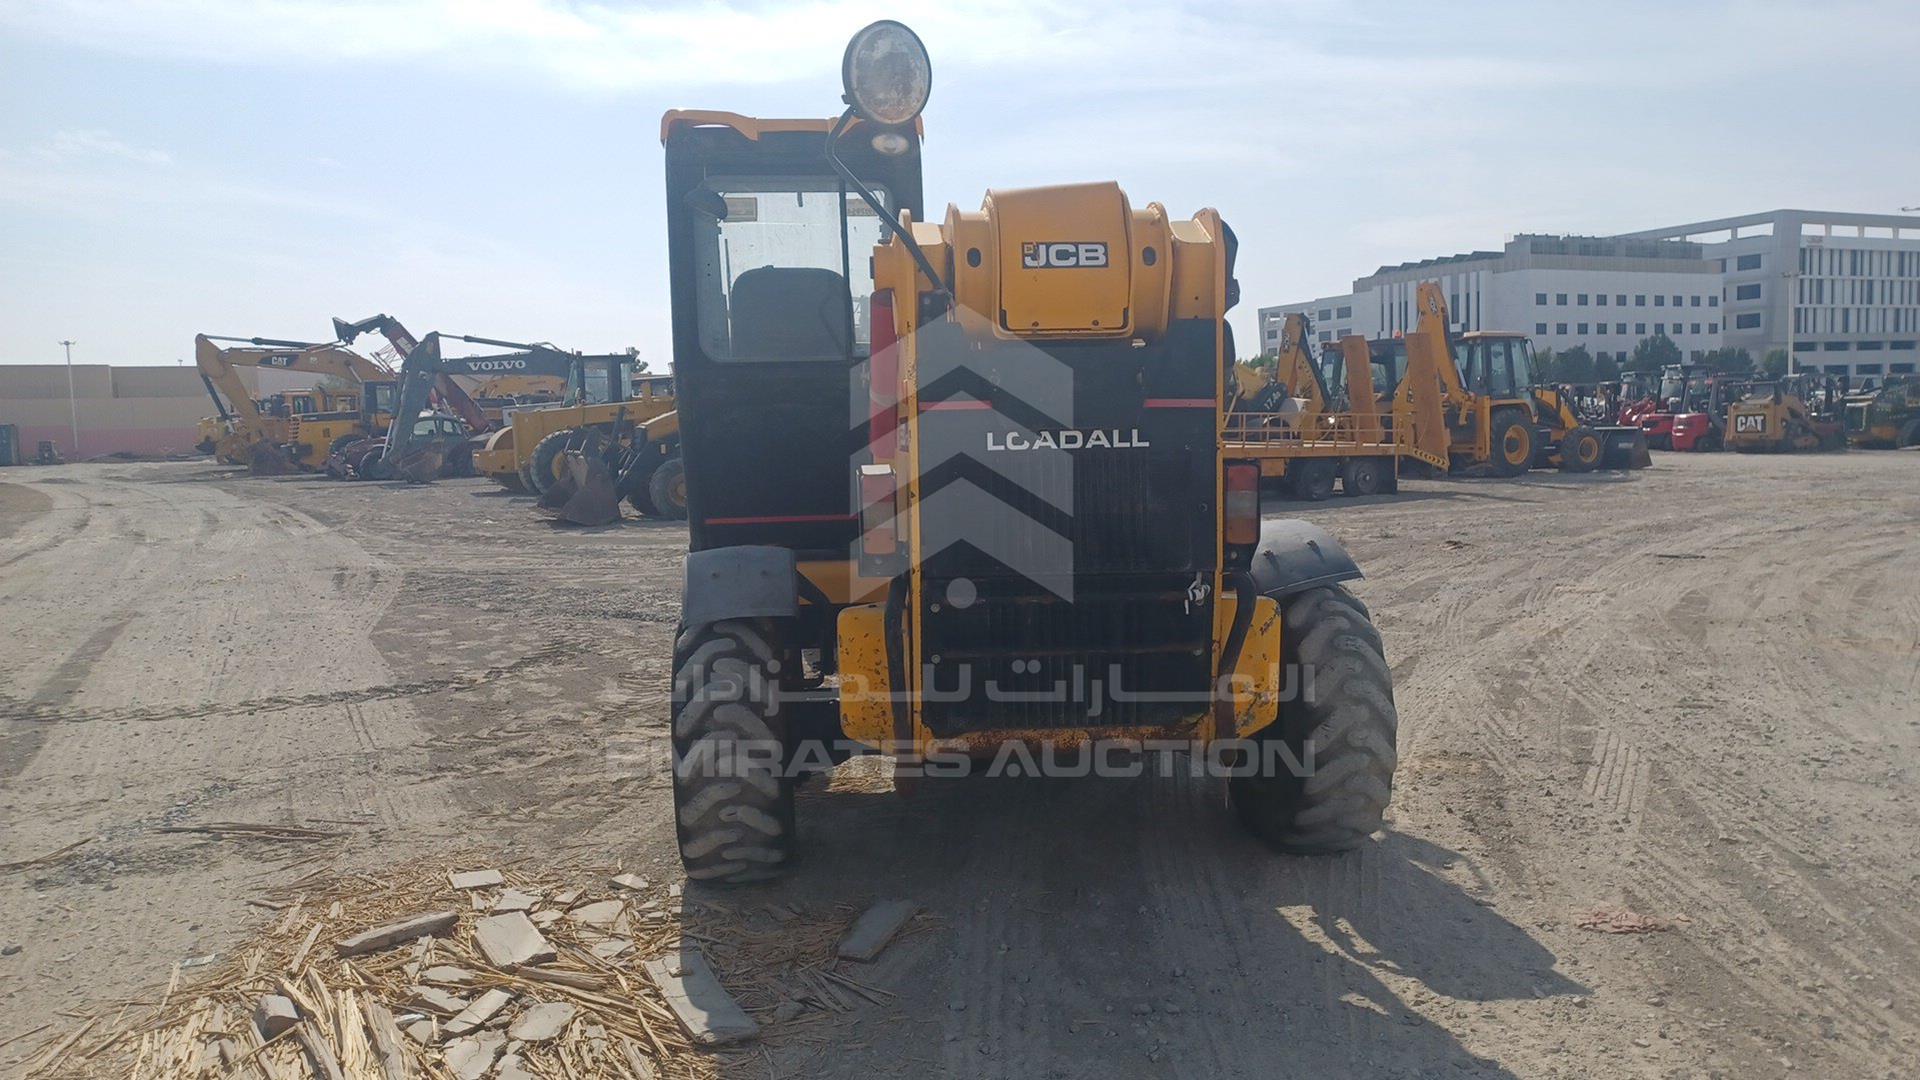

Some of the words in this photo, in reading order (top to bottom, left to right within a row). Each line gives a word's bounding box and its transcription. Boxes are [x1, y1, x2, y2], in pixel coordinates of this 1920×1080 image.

[1023, 243, 1107, 267] JCB
[271, 356, 288, 366] CAT
[466, 359, 526, 371] VOLVO
[1736, 415, 1764, 432] CAT
